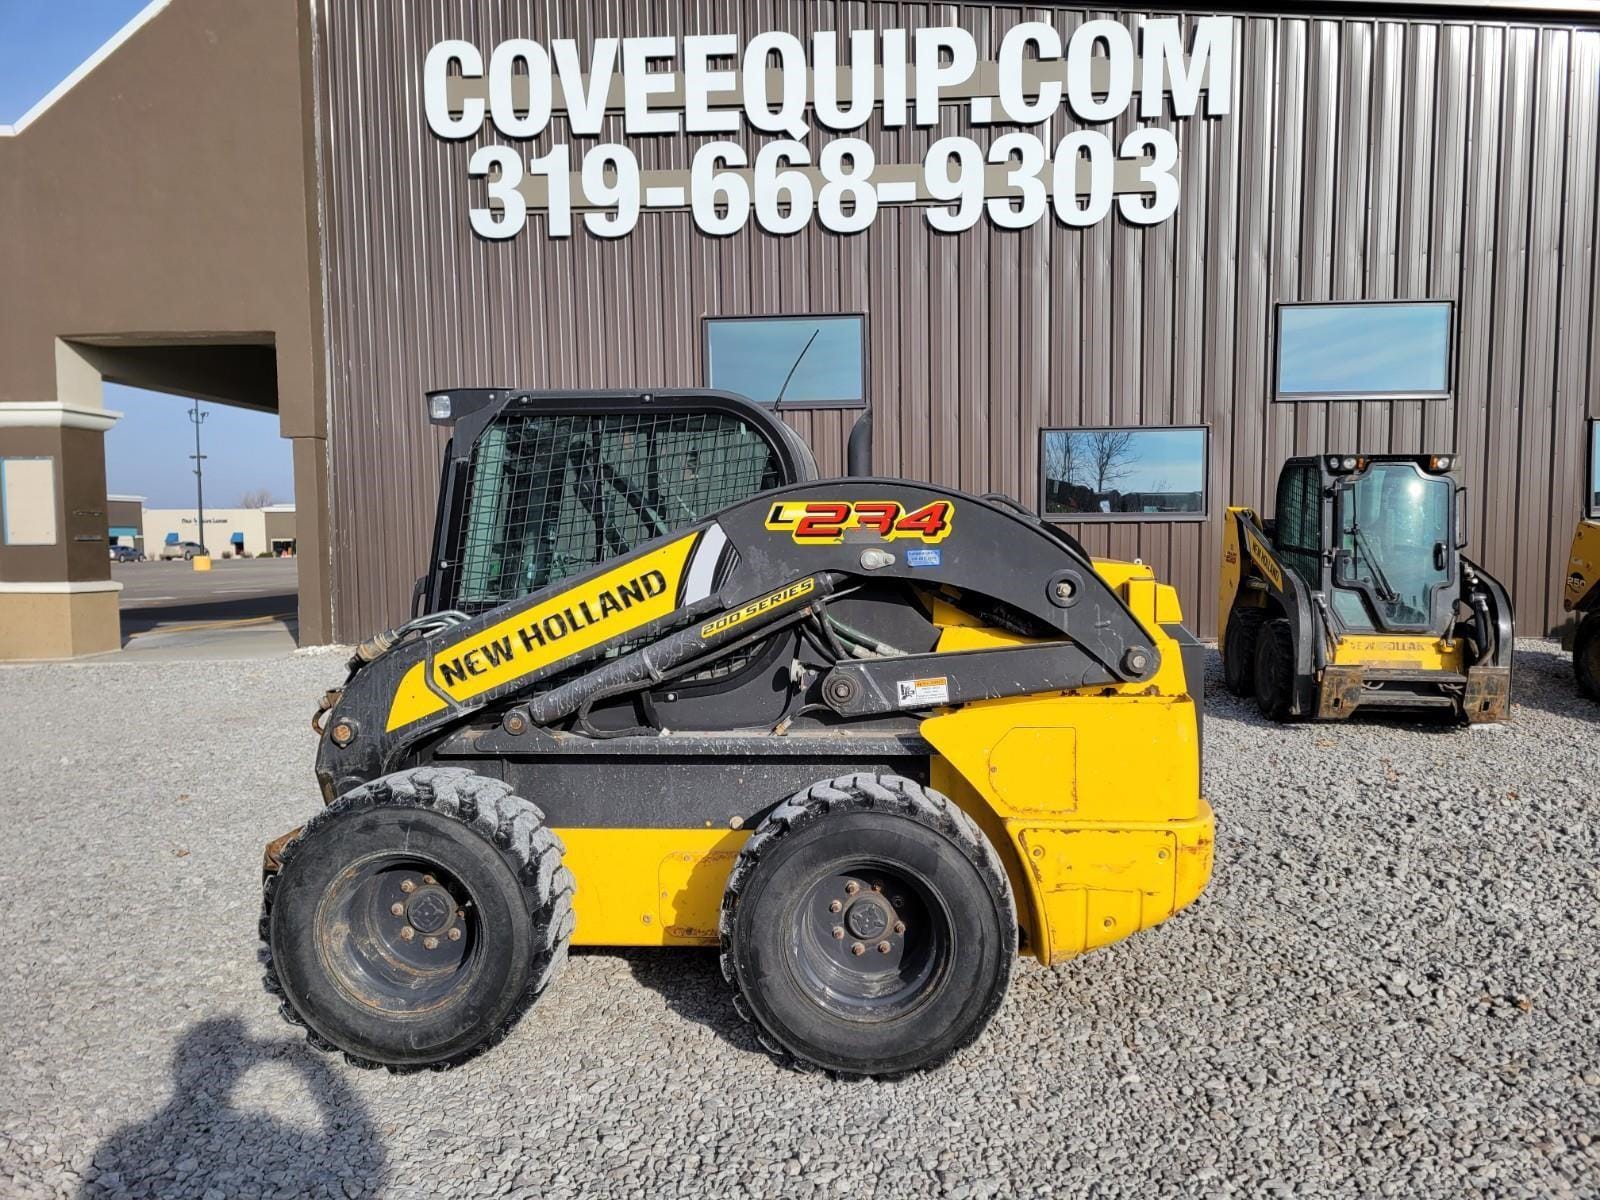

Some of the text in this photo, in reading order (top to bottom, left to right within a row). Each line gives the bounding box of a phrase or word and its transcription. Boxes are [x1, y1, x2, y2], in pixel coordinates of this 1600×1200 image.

[424, 14, 1233, 141] COVEEQUIP.COM
[469, 122, 1181, 239] 319-668-9303
[767, 502, 950, 539] L234
[702, 581, 812, 636] 200 SERIES
[1567, 576, 1586, 588] 250
[439, 568, 668, 688] NEW HOLLAND
